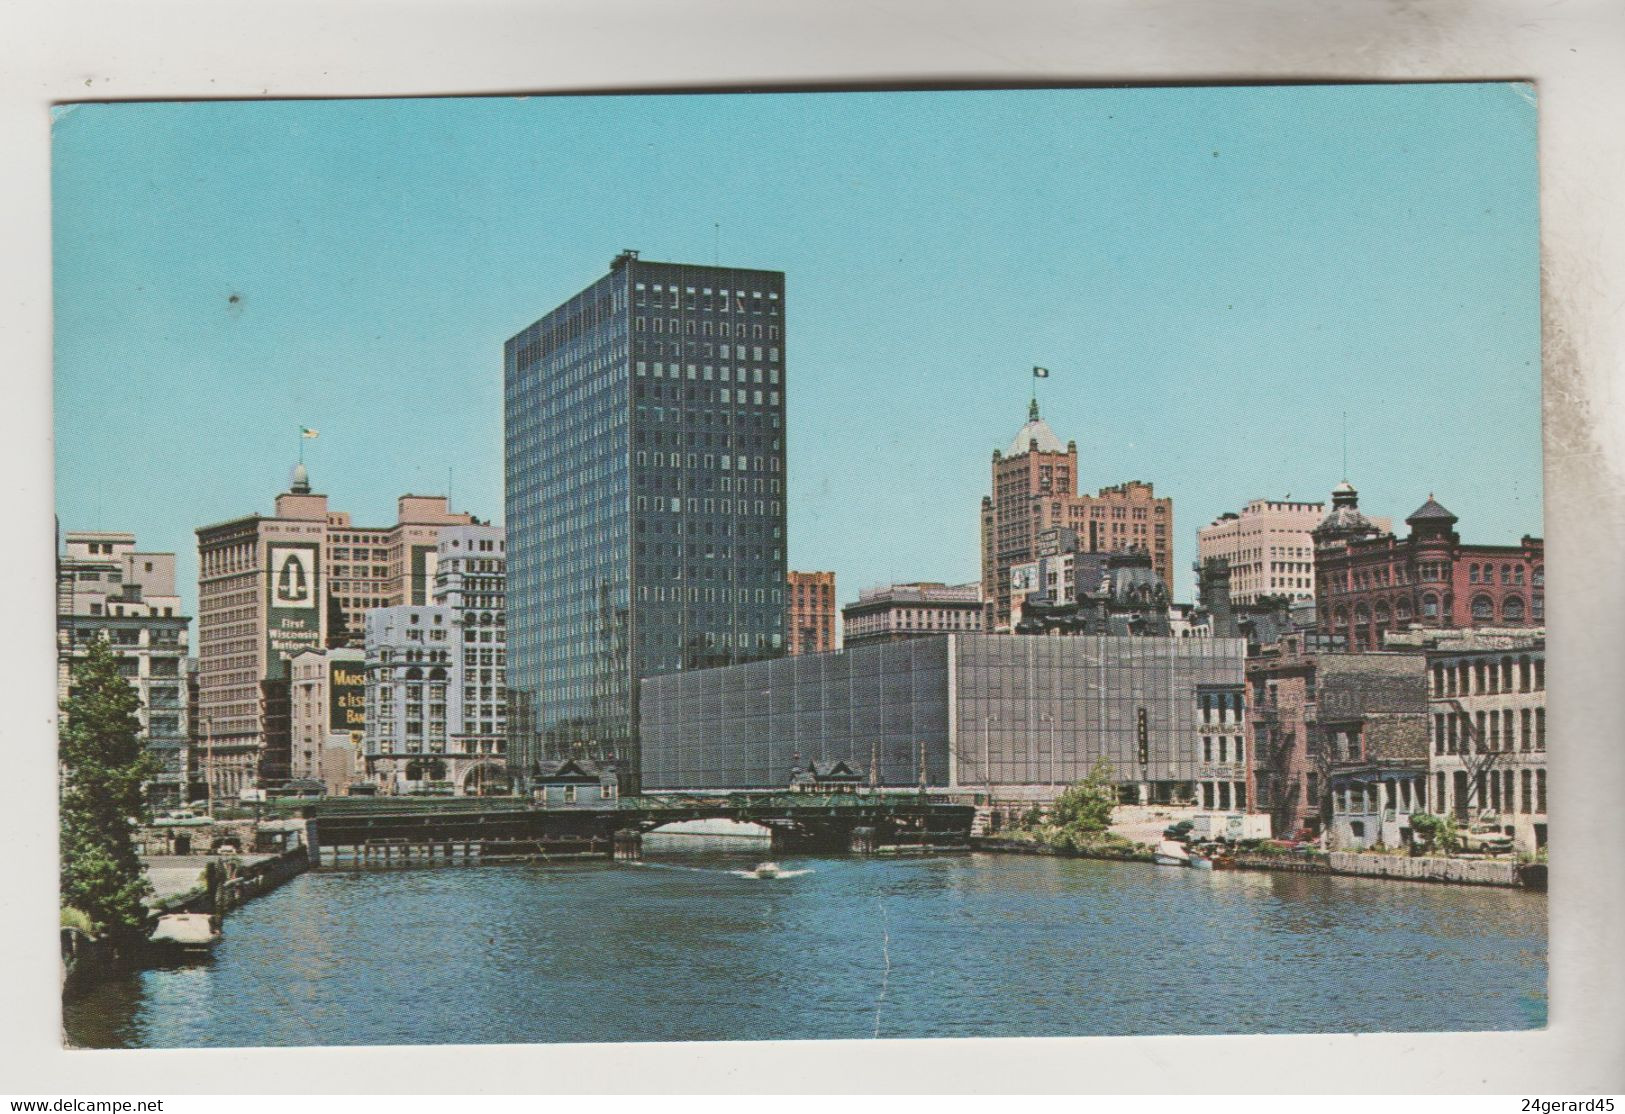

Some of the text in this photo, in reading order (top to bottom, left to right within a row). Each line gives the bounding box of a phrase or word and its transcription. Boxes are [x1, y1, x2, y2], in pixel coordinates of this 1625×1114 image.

[281, 618, 305, 628] First
[269, 629, 319, 639] Wisconsin
[272, 640, 315, 649] National
[347, 709, 366, 724] BAN
